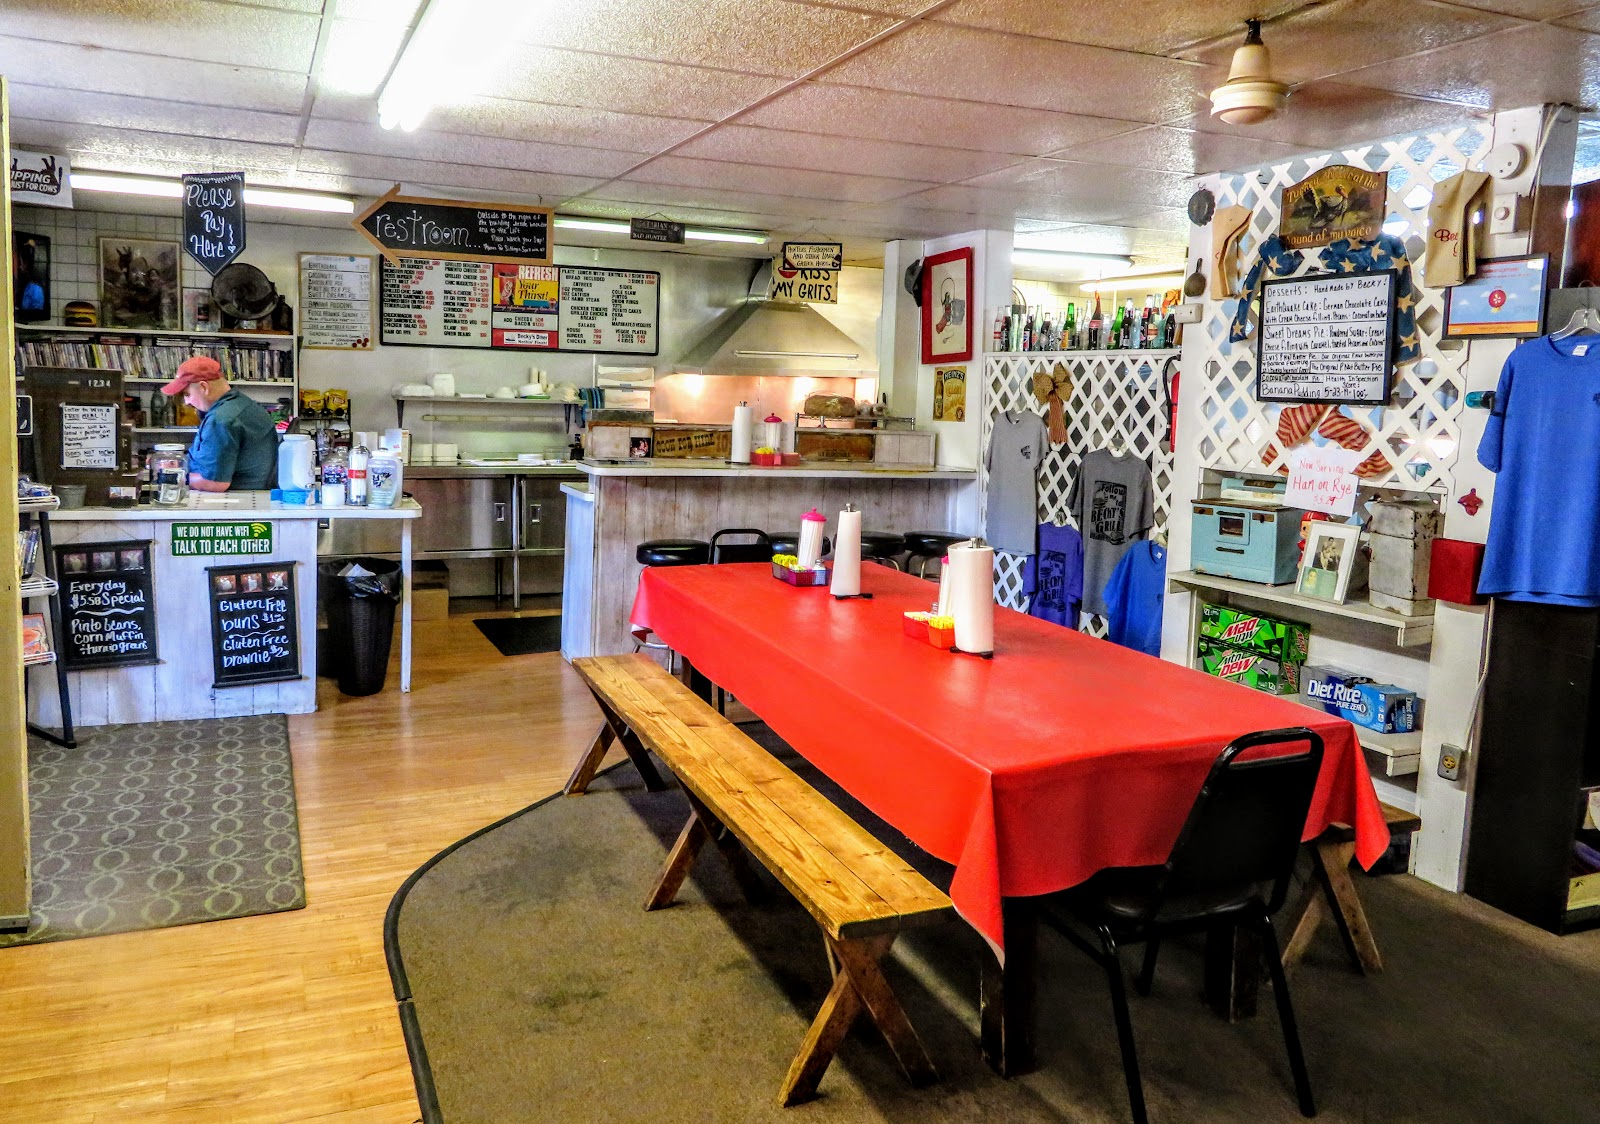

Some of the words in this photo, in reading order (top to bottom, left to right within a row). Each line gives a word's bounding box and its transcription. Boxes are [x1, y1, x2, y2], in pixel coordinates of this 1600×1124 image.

[11, 171, 50, 184] IPPING
[1364, 172, 1378, 189] the
[12, 181, 25, 190] UST
[26, 182, 38, 191] FOR
[186, 184, 236, 210] Please
[200, 210, 225, 238] Pay
[1316, 228, 1328, 240] of
[1330, 230, 1344, 240] my
[190, 235, 226, 258] Here
[518, 265, 559, 281] REFRESH
[800, 270, 830, 281] KISS
[518, 280, 539, 290] Your
[772, 280, 794, 298] MY
[798, 283, 832, 300] GRITS
[518, 290, 548, 300] Thirst!
[1344, 299, 1372, 308] Chocolate
[1294, 313, 1312, 322] Cheese
[1264, 326, 1284, 340] Sweet
[1286, 326, 1311, 338] Dreams
[1262, 384, 1293, 396] Banana
[1300, 458, 1313, 470] Now
[1316, 460, 1344, 478] Serving
[1318, 480, 1328, 492] on
[1332, 477, 1352, 499] Rye
[176, 526, 187, 537] WE
[189, 526, 199, 537] DO
[201, 526, 214, 537] NOT
[216, 526, 233, 537] HAVE
[1096, 521, 1121, 533] GRILL
[174, 540, 198, 554] TALK
[199, 540, 211, 554] TO
[214, 539, 238, 553] EACH
[241, 539, 270, 553] OTHER
[70, 580, 126, 596] Everyday
[102, 589, 145, 607] Special
[220, 600, 265, 612] Gluten
[266, 597, 287, 612] Free
[72, 618, 101, 634] Pinto
[222, 614, 260, 632] buns
[105, 631, 144, 642] Muffin
[224, 638, 260, 651] Gluten
[263, 634, 289, 646] Free
[224, 650, 271, 668] brownie
[1307, 680, 1334, 698] Diet
[1334, 683, 1361, 703] Rite
[1336, 700, 1350, 709] PURE
